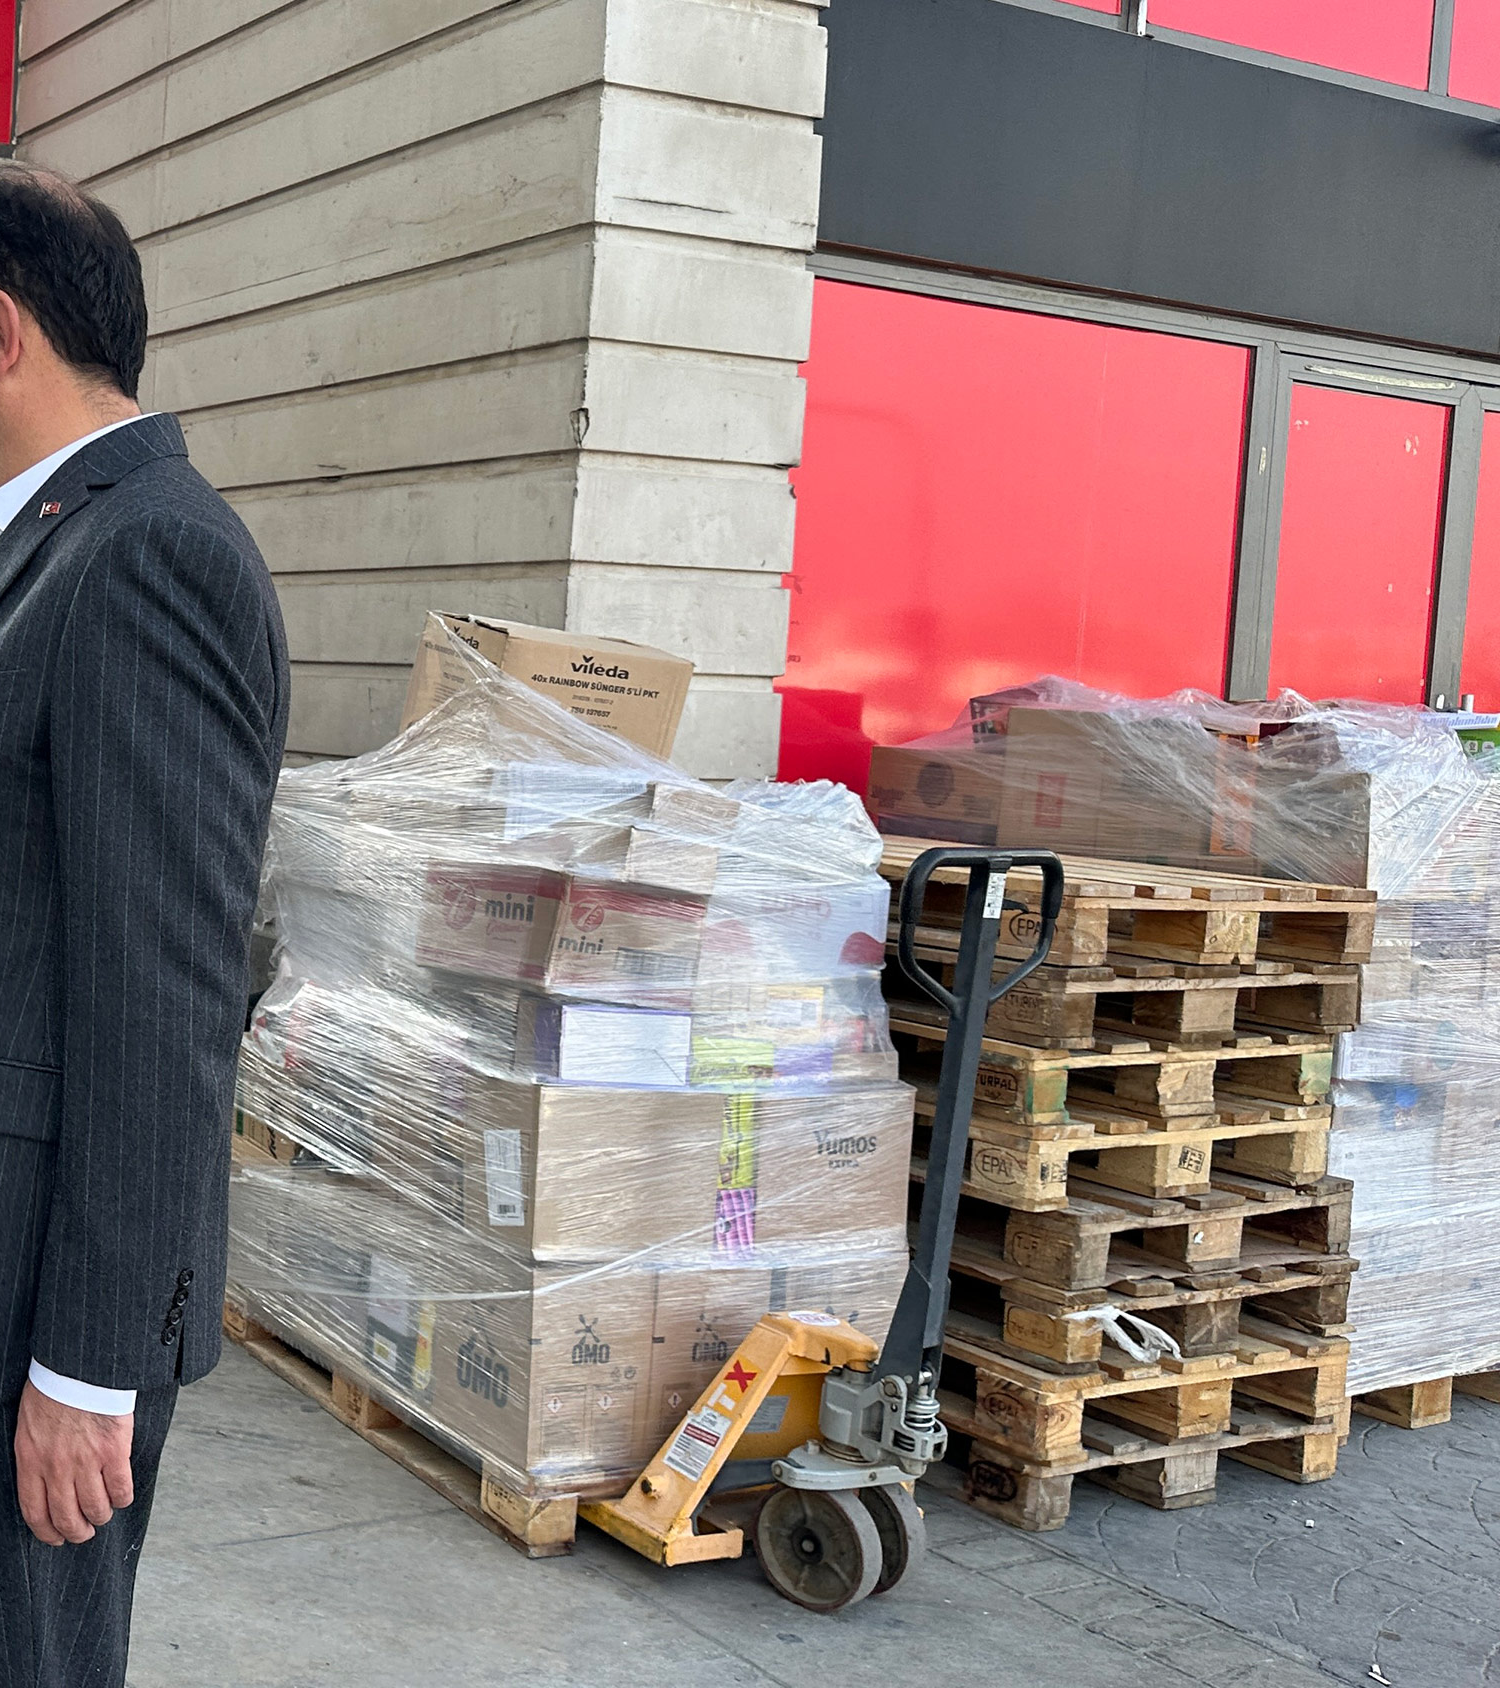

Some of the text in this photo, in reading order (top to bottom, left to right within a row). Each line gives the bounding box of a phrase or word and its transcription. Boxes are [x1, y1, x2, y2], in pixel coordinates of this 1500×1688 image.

[570, 655, 630, 680] vileda
[531, 674, 548, 684] 40x
[549, 676, 591, 689] RAINBOW
[591, 682, 626, 695] SÜNGER
[643, 689, 660, 699] PKT
[484, 893, 535, 923] mini
[1016, 917, 1042, 937] EPA
[558, 935, 605, 955] mini
[976, 1072, 1016, 1092] URPAL
[813, 1130, 877, 1155] Yumos
[571, 1343, 611, 1365] OMO
[456, 1346, 510, 1408] OMO
